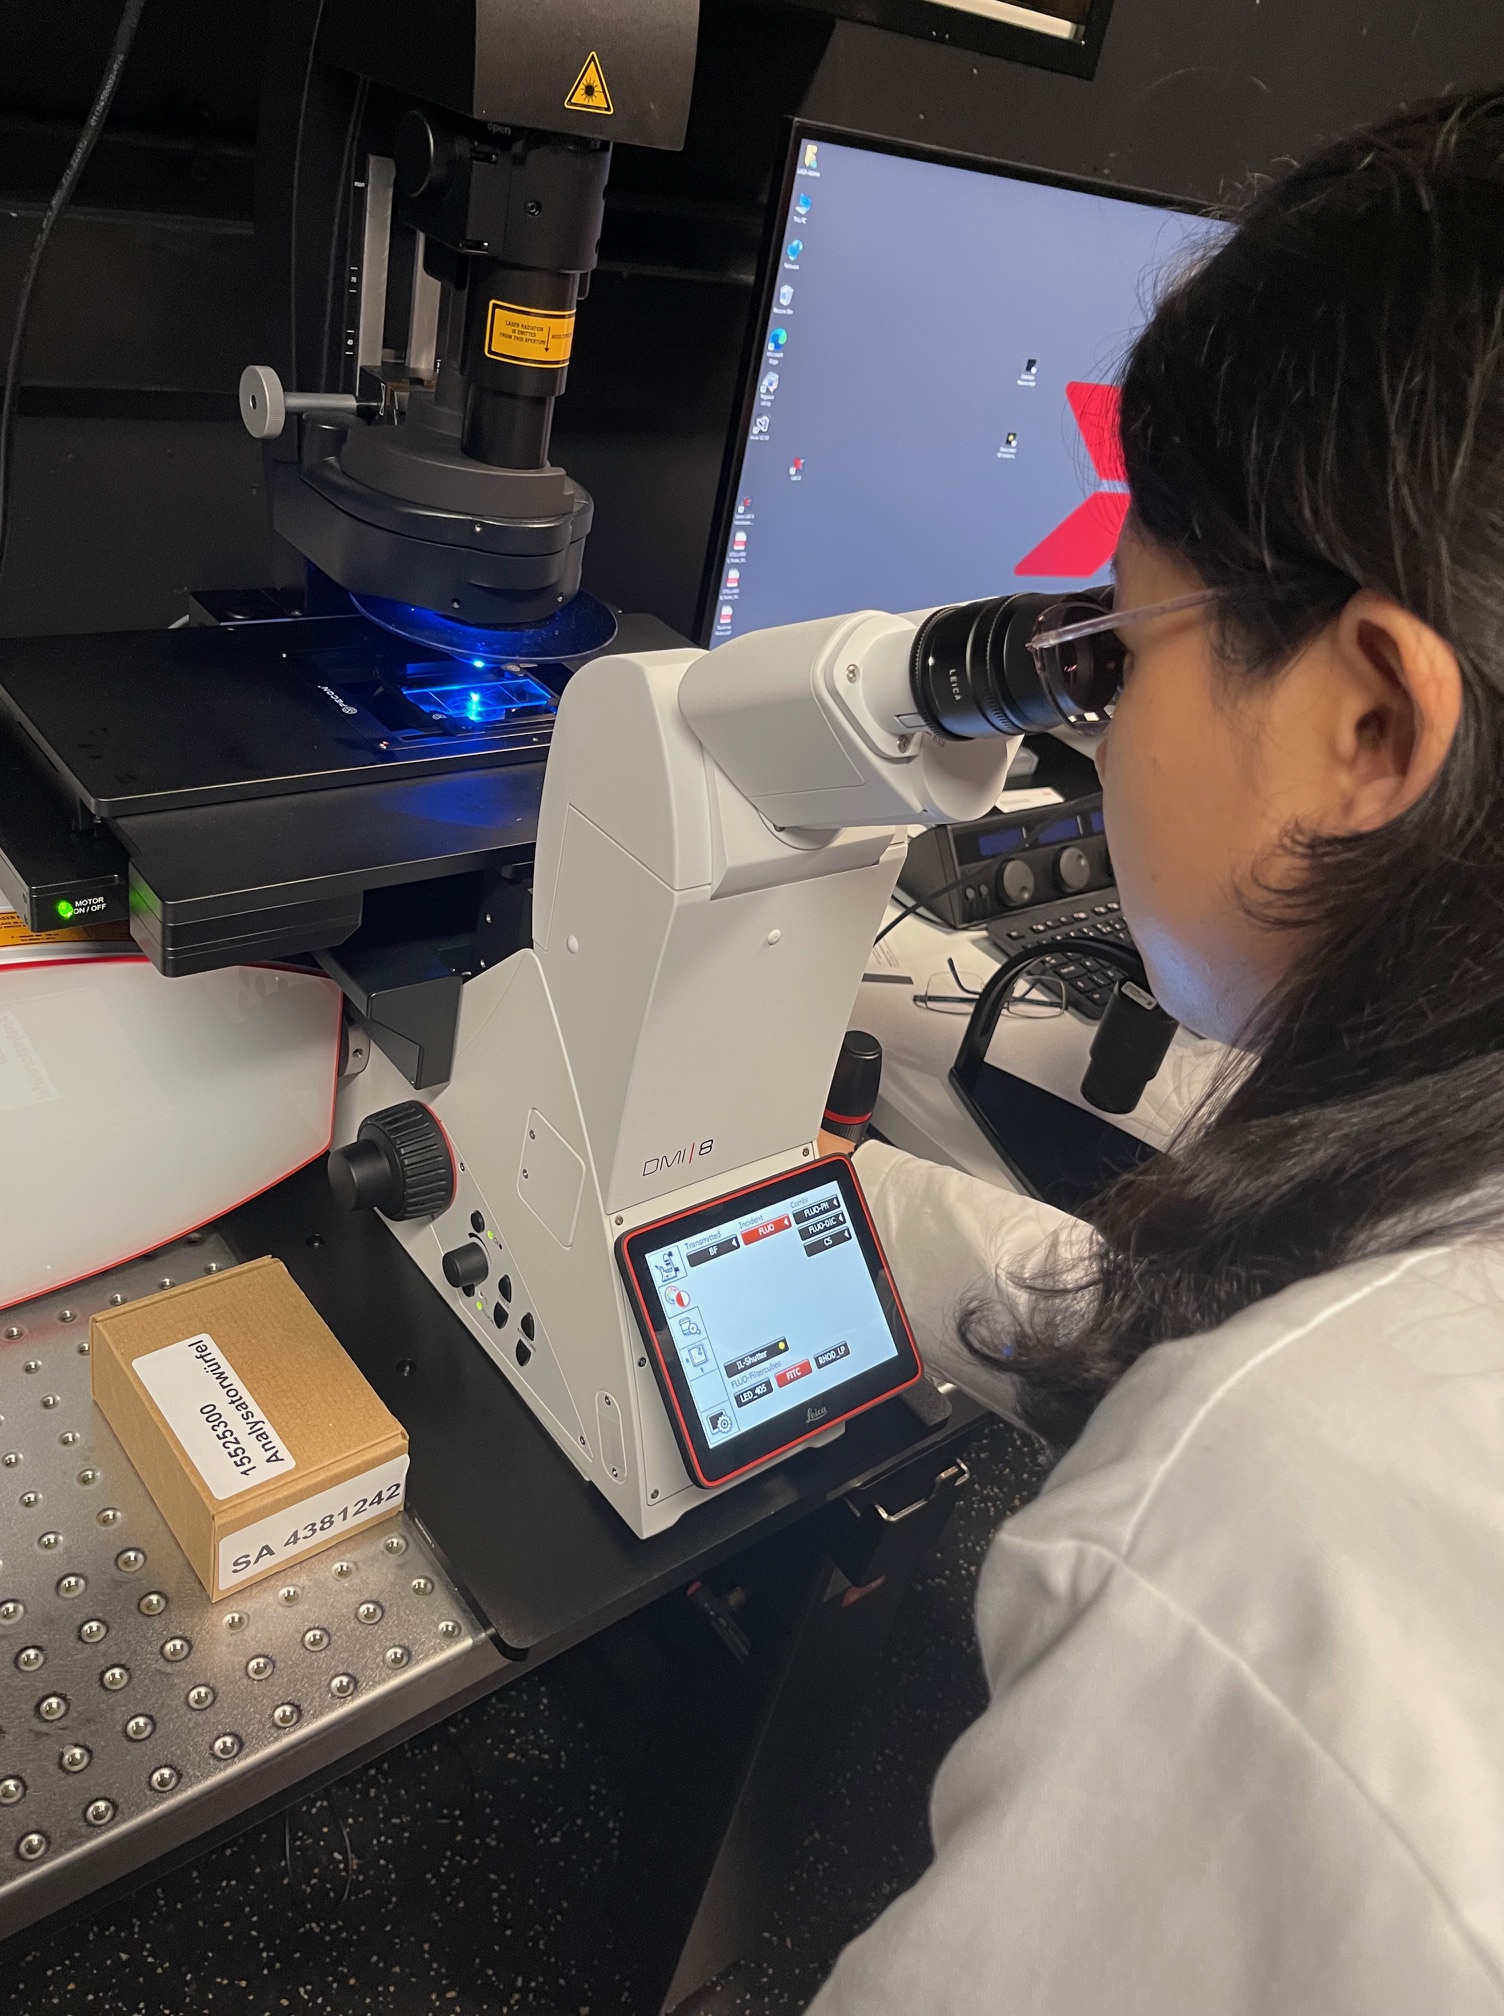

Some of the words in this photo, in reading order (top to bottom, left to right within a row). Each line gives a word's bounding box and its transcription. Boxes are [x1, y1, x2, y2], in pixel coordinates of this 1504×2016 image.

[505, 320, 520, 328] LASER
[521, 323, 544, 332] RADIATION
[499, 332, 513, 340] FROM
[524, 336, 546, 346] APERTURE
[949, 669, 962, 701] LEICA
[73, 907, 85, 915] ON
[91, 903, 107, 912] OFF
[75, 897, 104, 907] MOTOR
[790, 1197, 808, 1209] Combi
[803, 1202, 830, 1218] FLUO-PH
[738, 1214, 764, 1230] Incident
[758, 1223, 775, 1236] FLUO
[808, 1217, 837, 1234] FLUO-DIC
[684, 1230, 722, 1250] Transmitted
[823, 1237, 833, 1247] CS
[735, 1350, 768, 1370] IL-Shutter
[818, 1345, 846, 1366] RHOD_LP
[731, 1361, 782, 1389] FLUO-Filtercubes
[785, 1367, 802, 1381] FITC
[187, 1339, 285, 1464] Analysatorwürfel
[739, 1384, 767, 1403] LED_405
[805, 1406, 828, 1424] Leica
[199, 1402, 257, 1477] 15525300
[231, 1543, 276, 1575] SA
[283, 1482, 402, 1549] 4381242
